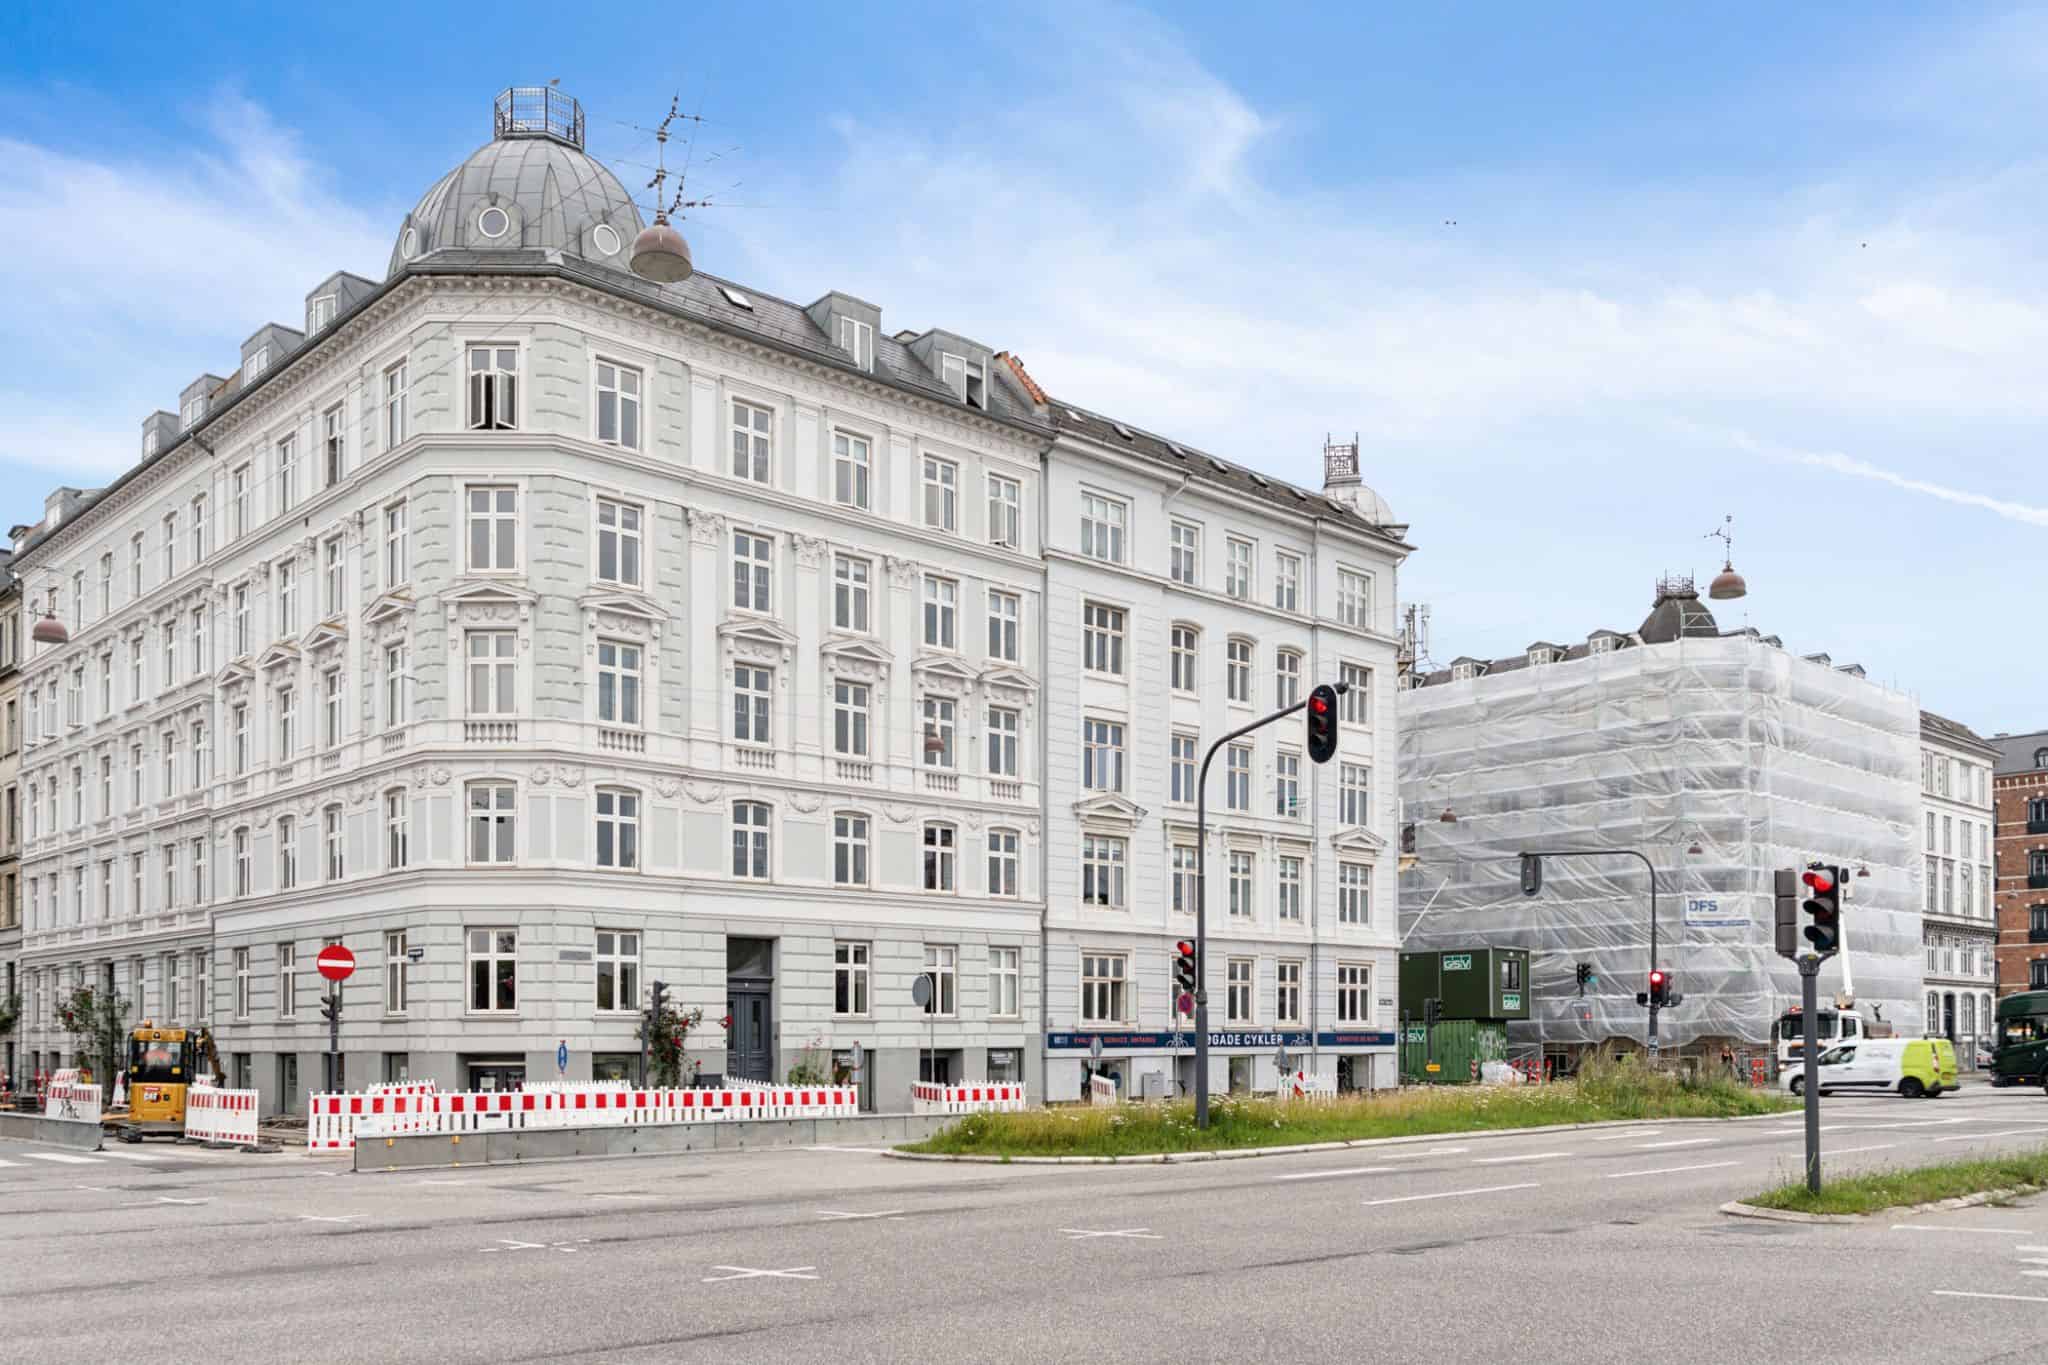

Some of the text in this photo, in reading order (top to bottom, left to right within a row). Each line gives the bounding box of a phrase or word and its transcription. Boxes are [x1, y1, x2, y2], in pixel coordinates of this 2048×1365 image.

[1688, 900, 1718, 912] DFS
[1443, 958, 1471, 970] GSV
[1244, 1034, 1284, 1046] CYKLER
